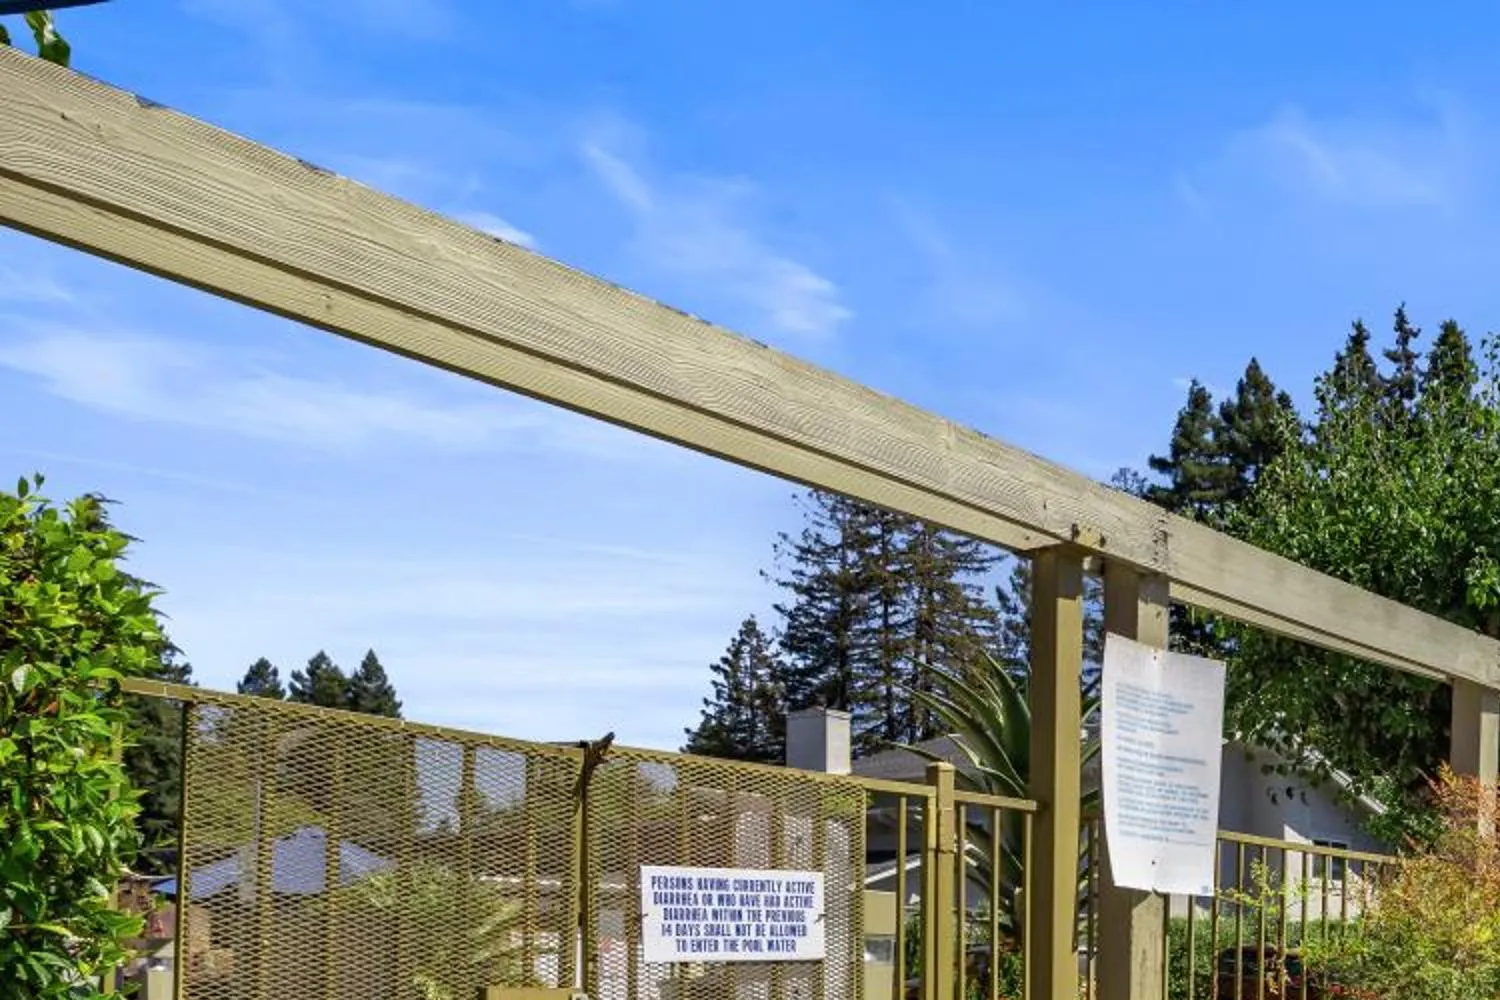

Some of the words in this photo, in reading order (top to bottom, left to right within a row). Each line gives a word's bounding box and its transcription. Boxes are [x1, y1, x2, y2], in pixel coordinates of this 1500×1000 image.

[651, 876, 694, 890] PERSONS
[697, 877, 730, 892] HAVING
[733, 879, 782, 893] CURRENTLY
[785, 881, 815, 895] ACTIVE
[653, 891, 699, 906] DIARRHEA
[701, 893, 713, 906] OR
[717, 893, 736, 907] WHO
[739, 894, 761, 908] HAVE
[764, 895, 781, 908] HAD
[784, 895, 814, 909] ACTIVE
[663, 907, 709, 921] DIARRHEA
[711, 908, 743, 922] WITHIN
[746, 909, 762, 922] THE
[765, 909, 805, 922] PREVIOUS
[661, 924, 672, 936] 14
[675, 923, 701, 936] DAYS
[703, 923, 732, 937] SHALL
[735, 923, 752, 937] NOT
[755, 923, 766, 937] BE
[769, 923, 807, 937] ALLOWED
[676, 938, 687, 952] TO
[691, 938, 719, 952] ENTER
[723, 938, 739, 952] THE
[741, 938, 763, 952] POOL
[767, 938, 797, 952] WATER
